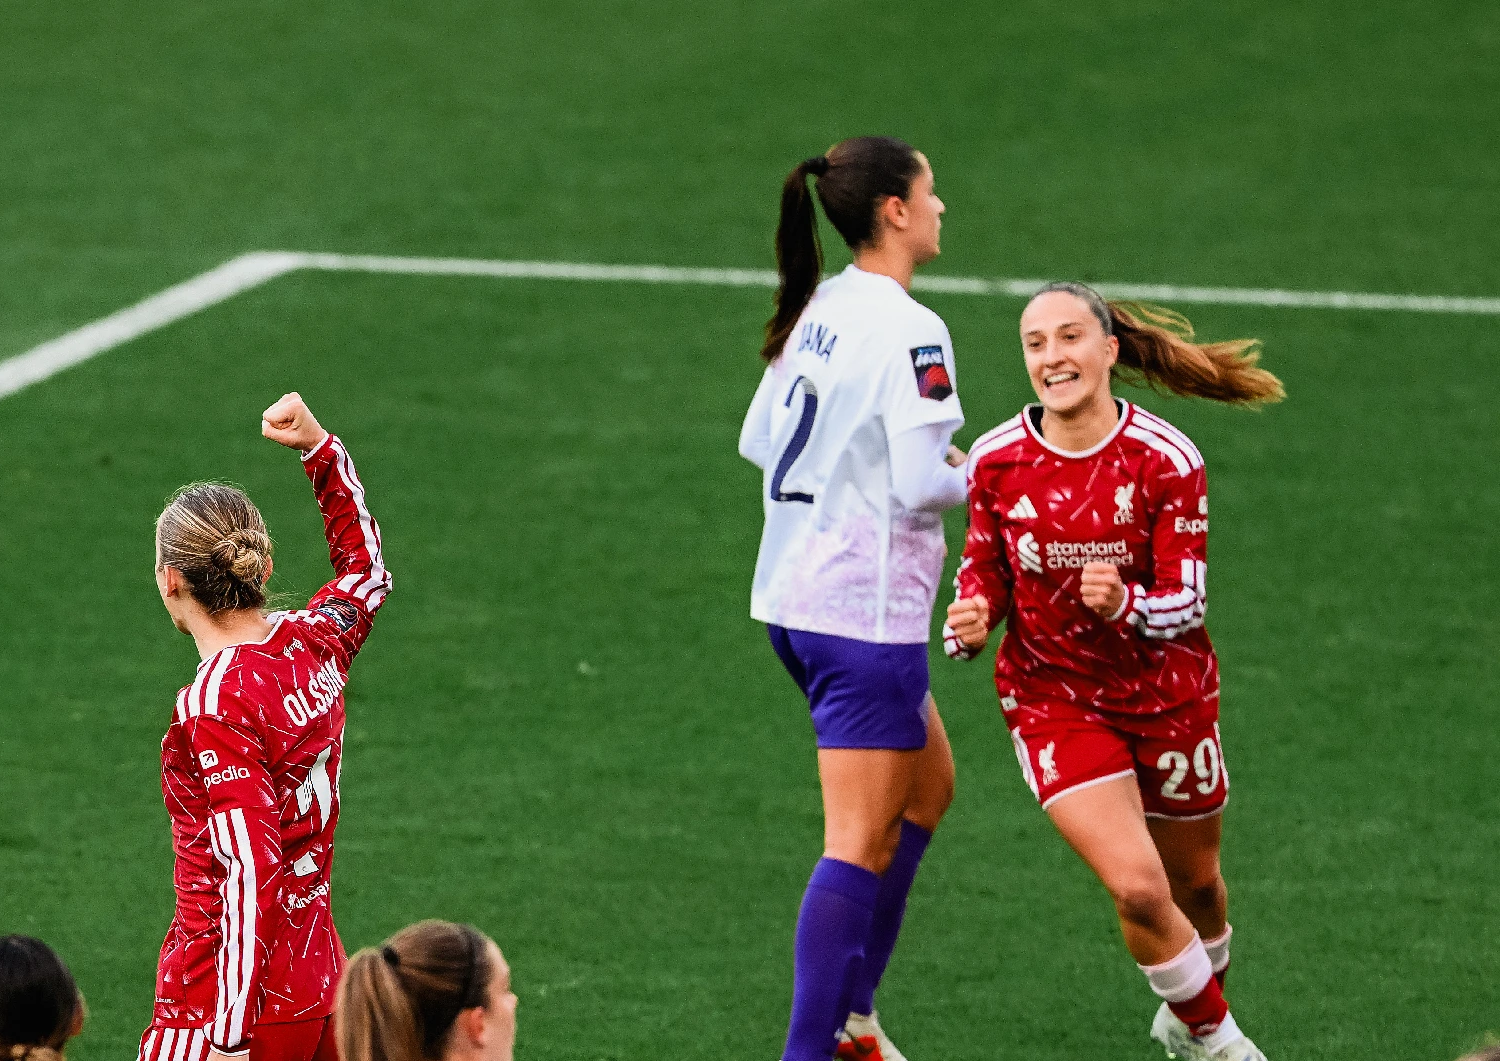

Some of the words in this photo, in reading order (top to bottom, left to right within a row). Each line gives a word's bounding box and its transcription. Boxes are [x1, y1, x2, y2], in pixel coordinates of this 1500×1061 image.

[771, 375, 819, 504] 2
[1045, 539, 1128, 557] standard
[1156, 737, 1220, 801] 29
